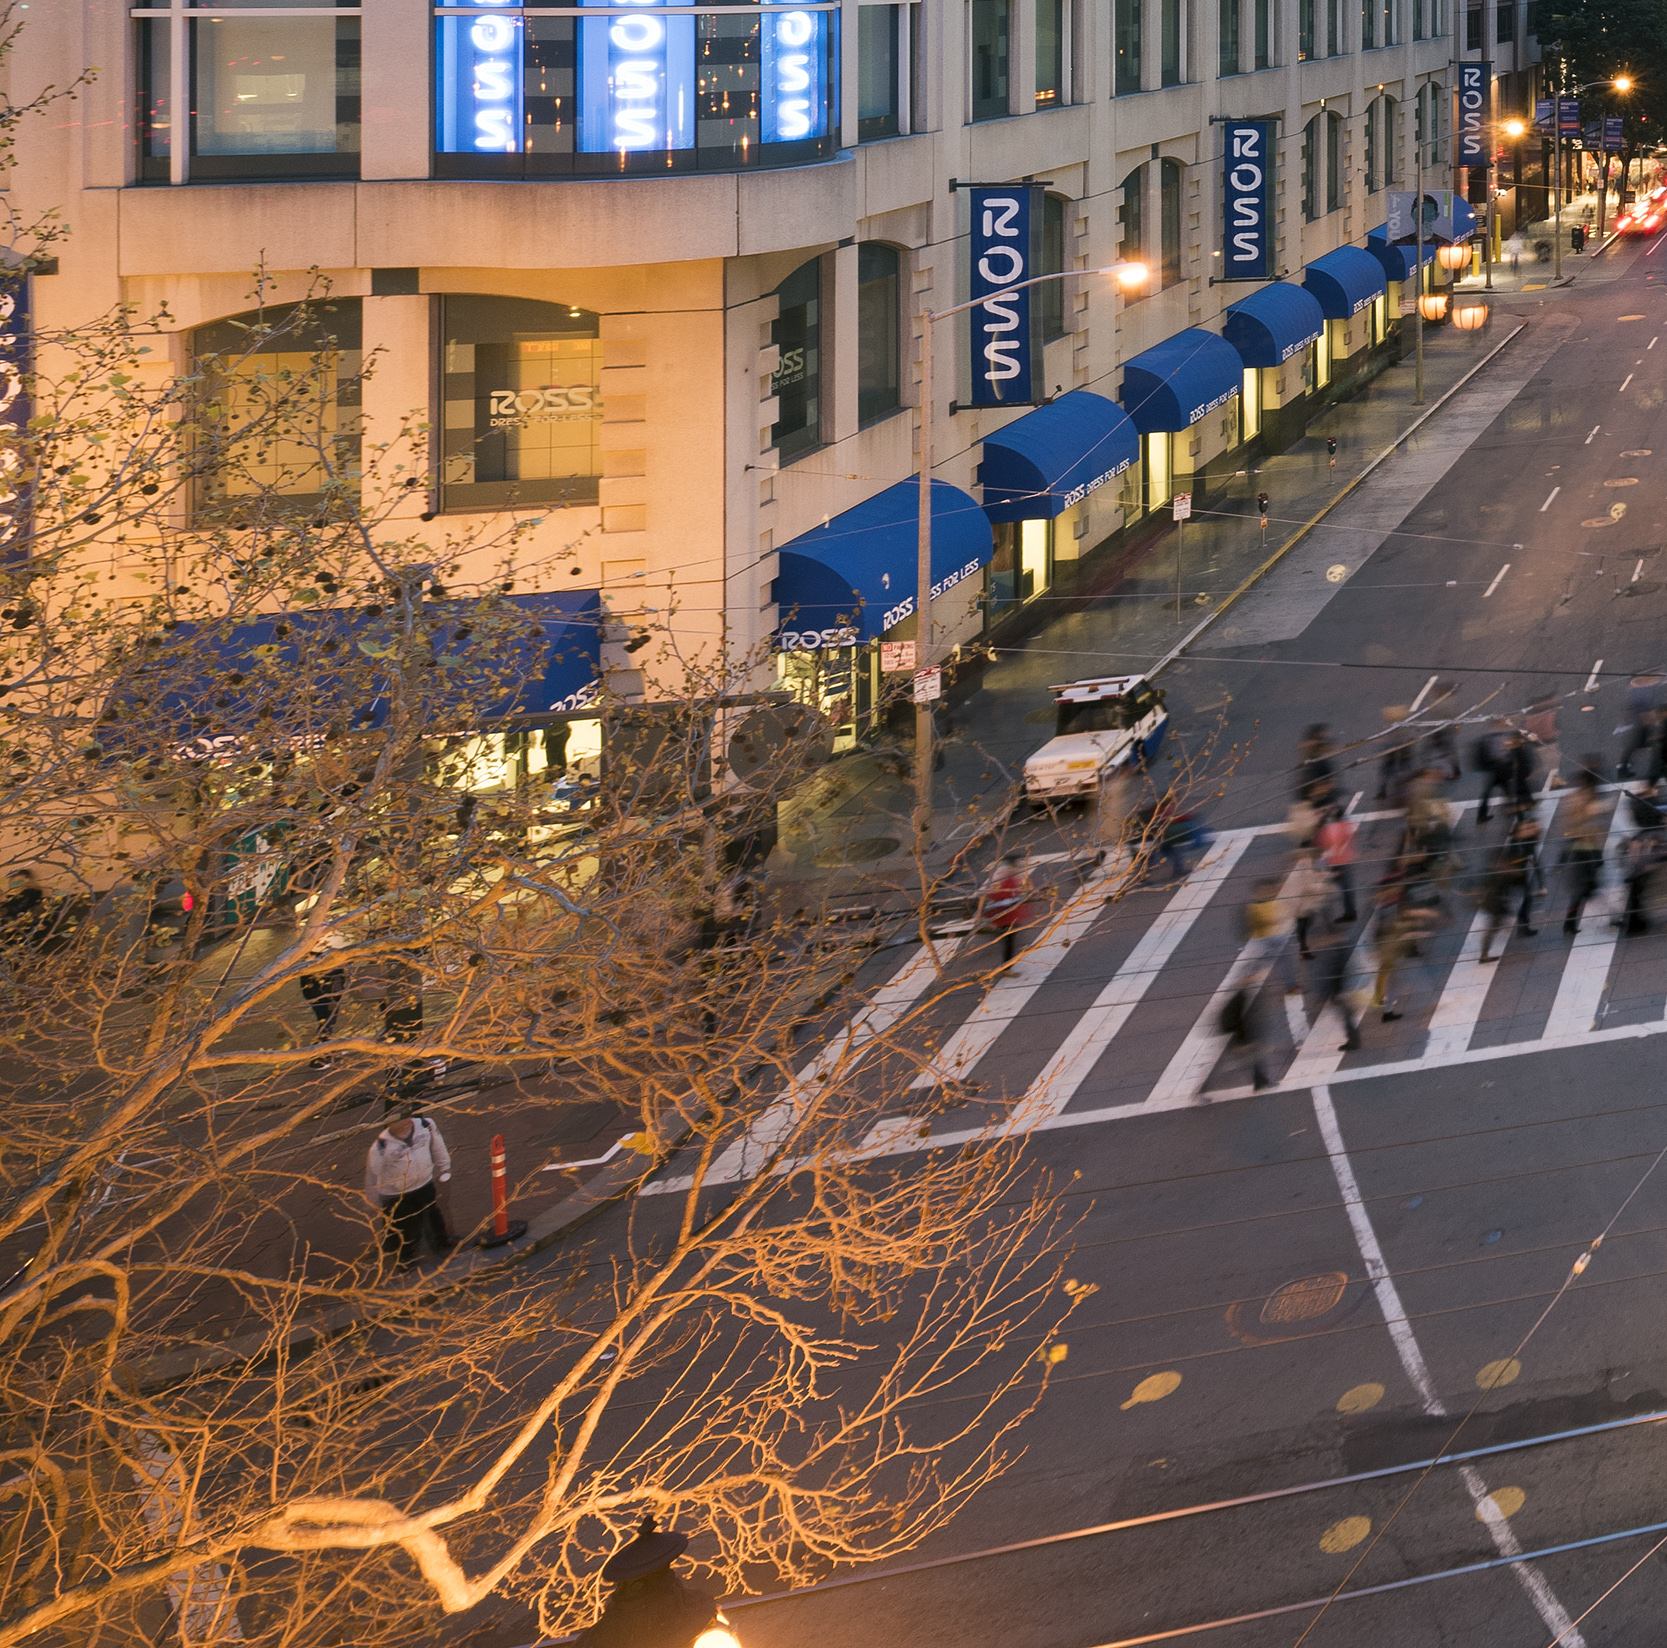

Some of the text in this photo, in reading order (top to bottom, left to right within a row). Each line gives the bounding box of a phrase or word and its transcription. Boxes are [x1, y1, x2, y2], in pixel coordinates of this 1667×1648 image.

[1463, 68, 1482, 155] ROSS
[1230, 129, 1262, 261] ROSS
[978, 198, 1024, 380] ROSS
[1282, 344, 1294, 361] ROSS
[490, 387, 593, 416] ROSS
[1189, 403, 1205, 425] ROSS
[1219, 393, 1227, 404] FOR
[1064, 458, 1130, 510] ROSS DRESS FOR LESS
[943, 558, 979, 592] FOR LESS
[883, 596, 914, 632] ROSS
[782, 627, 857, 651] ROSS
